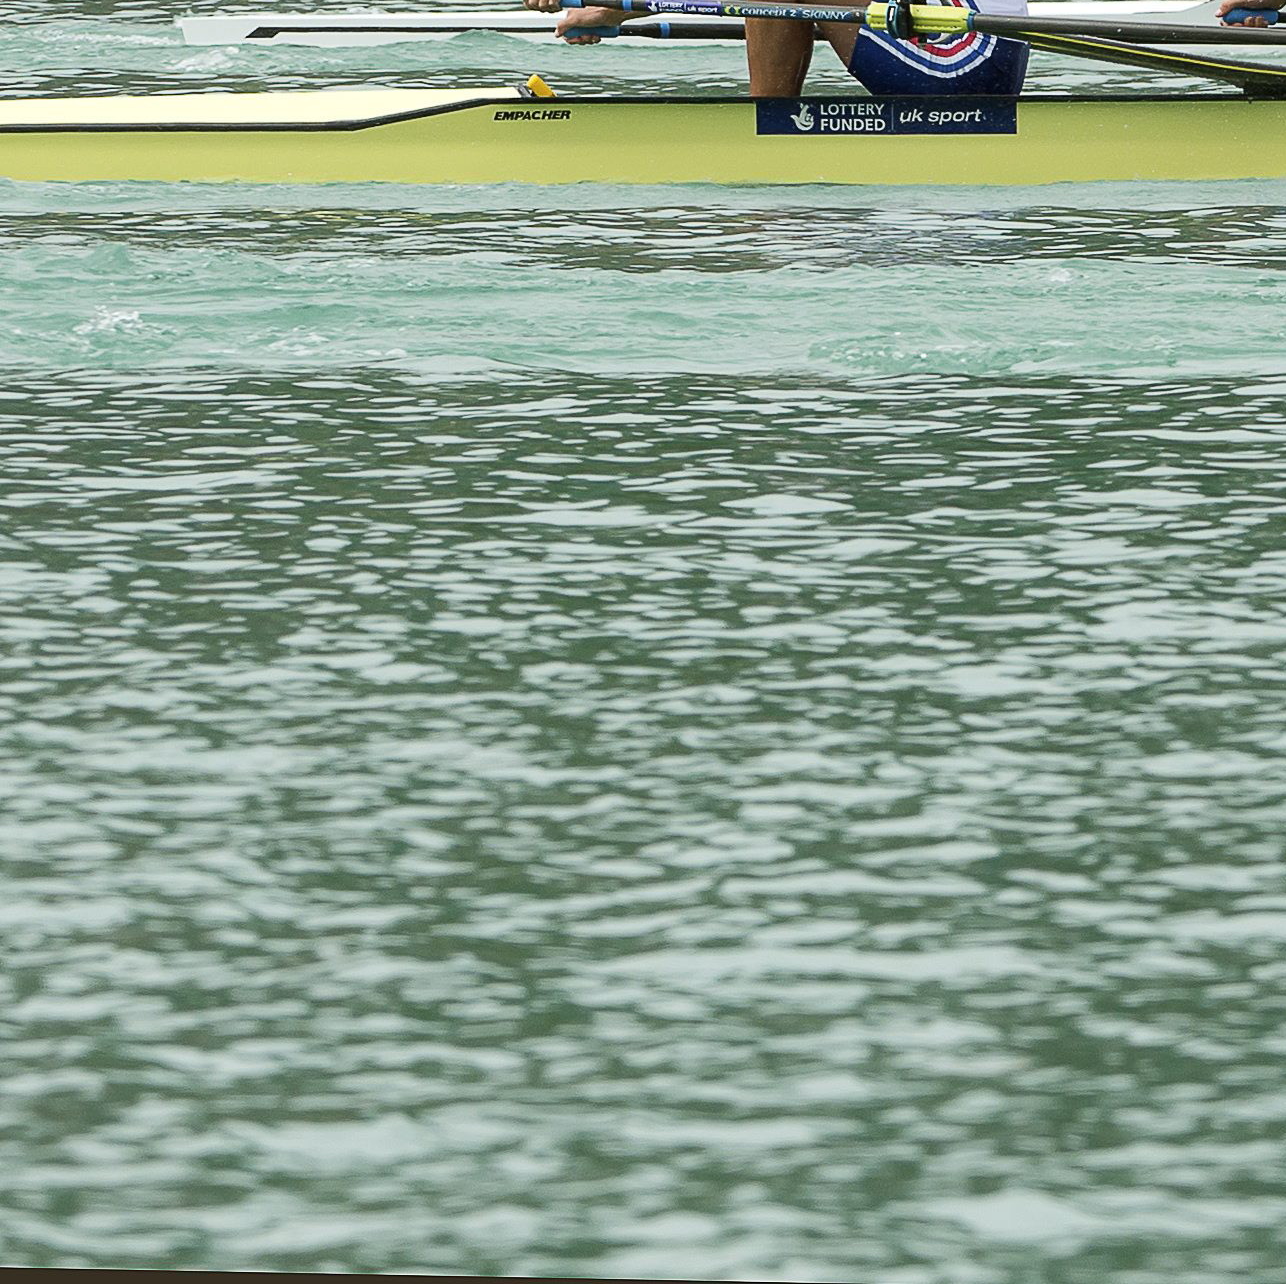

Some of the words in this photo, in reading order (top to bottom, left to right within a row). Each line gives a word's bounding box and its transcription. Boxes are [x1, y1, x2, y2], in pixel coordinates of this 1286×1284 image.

[741, 7, 788, 17] concept
[789, 9, 797, 17] 2
[801, 10, 849, 20] SKINNY
[493, 110, 572, 121] EMPACHER
[820, 103, 885, 116] LOTTERY
[900, 108, 923, 123] uk
[928, 108, 983, 126] sport
[820, 118, 886, 132] FUNDED
